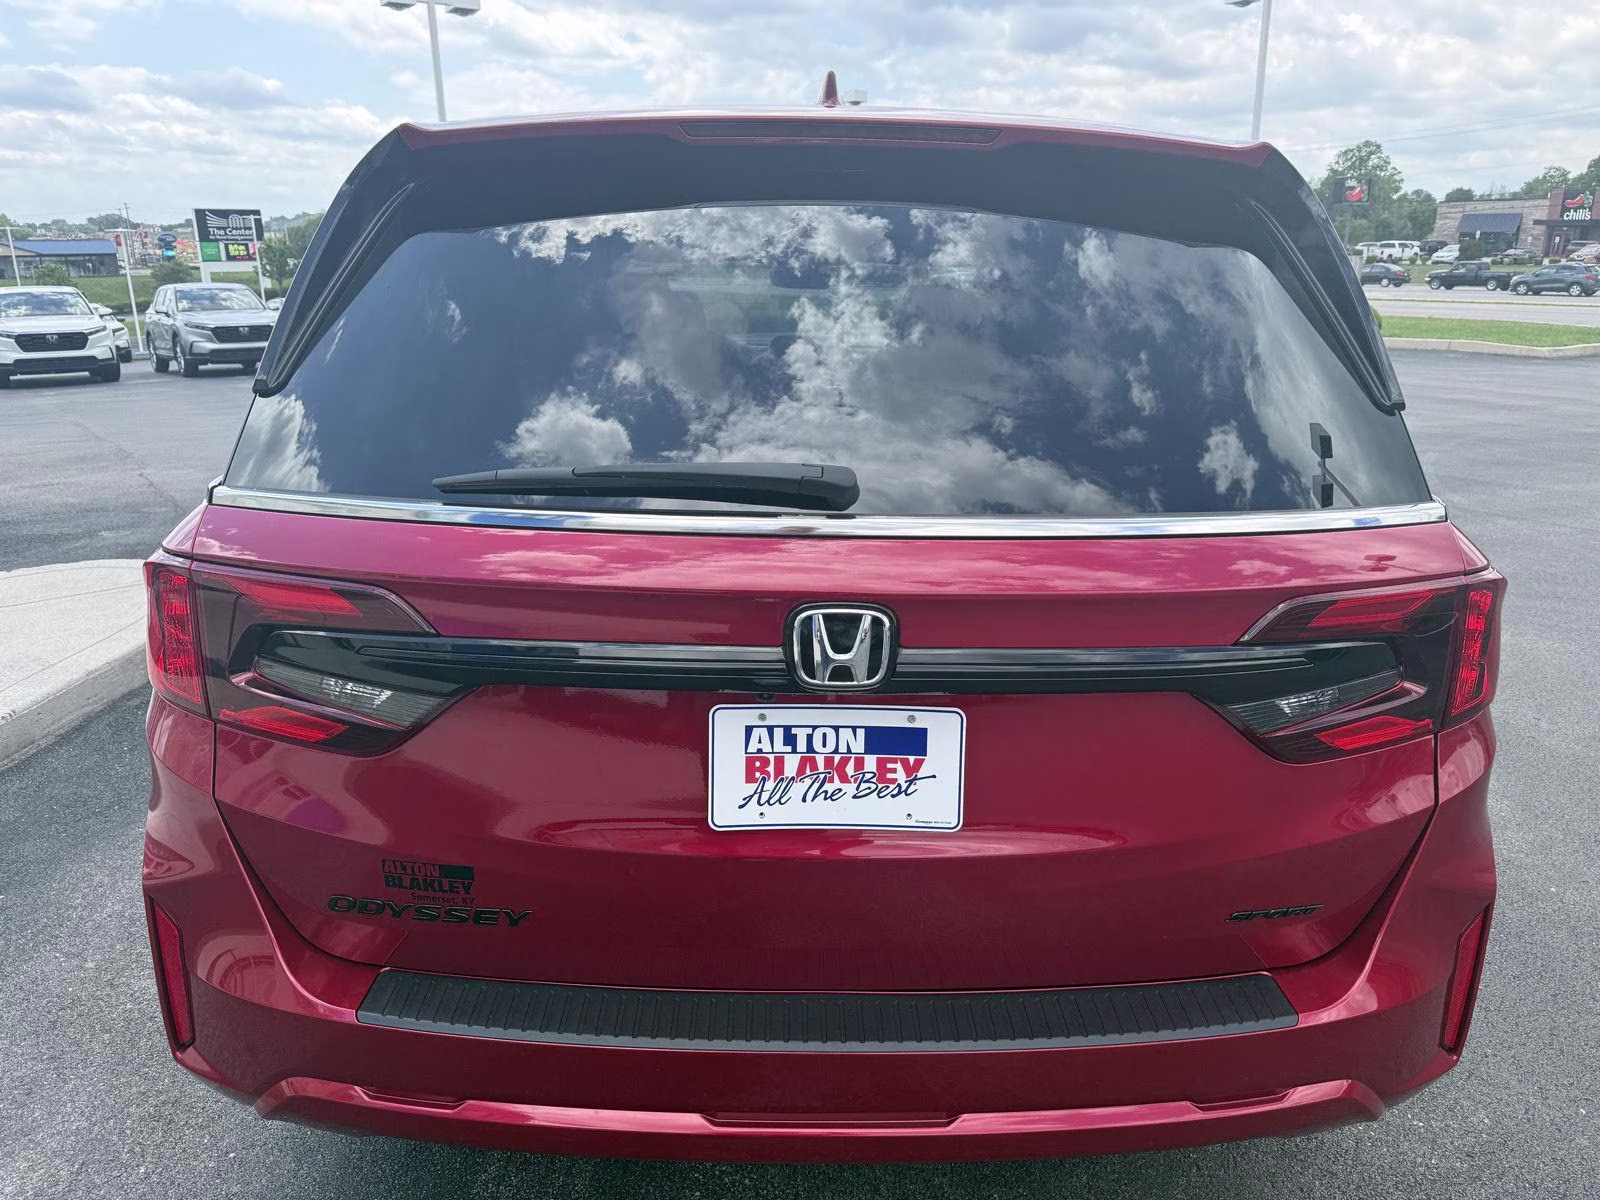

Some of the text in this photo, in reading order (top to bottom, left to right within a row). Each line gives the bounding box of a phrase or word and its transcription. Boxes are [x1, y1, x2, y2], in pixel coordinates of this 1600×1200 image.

[1563, 208, 1592, 221] chili's
[209, 228, 254, 236] The Center
[746, 727, 866, 754] ALTON
[744, 755, 926, 785] BLAKLEY
[737, 770, 937, 810] All The Best
[383, 860, 440, 877] ALTON
[384, 874, 473, 895] BLAKLEY
[328, 895, 534, 927] ODYSSEY
[1225, 903, 1324, 922] SPORT
